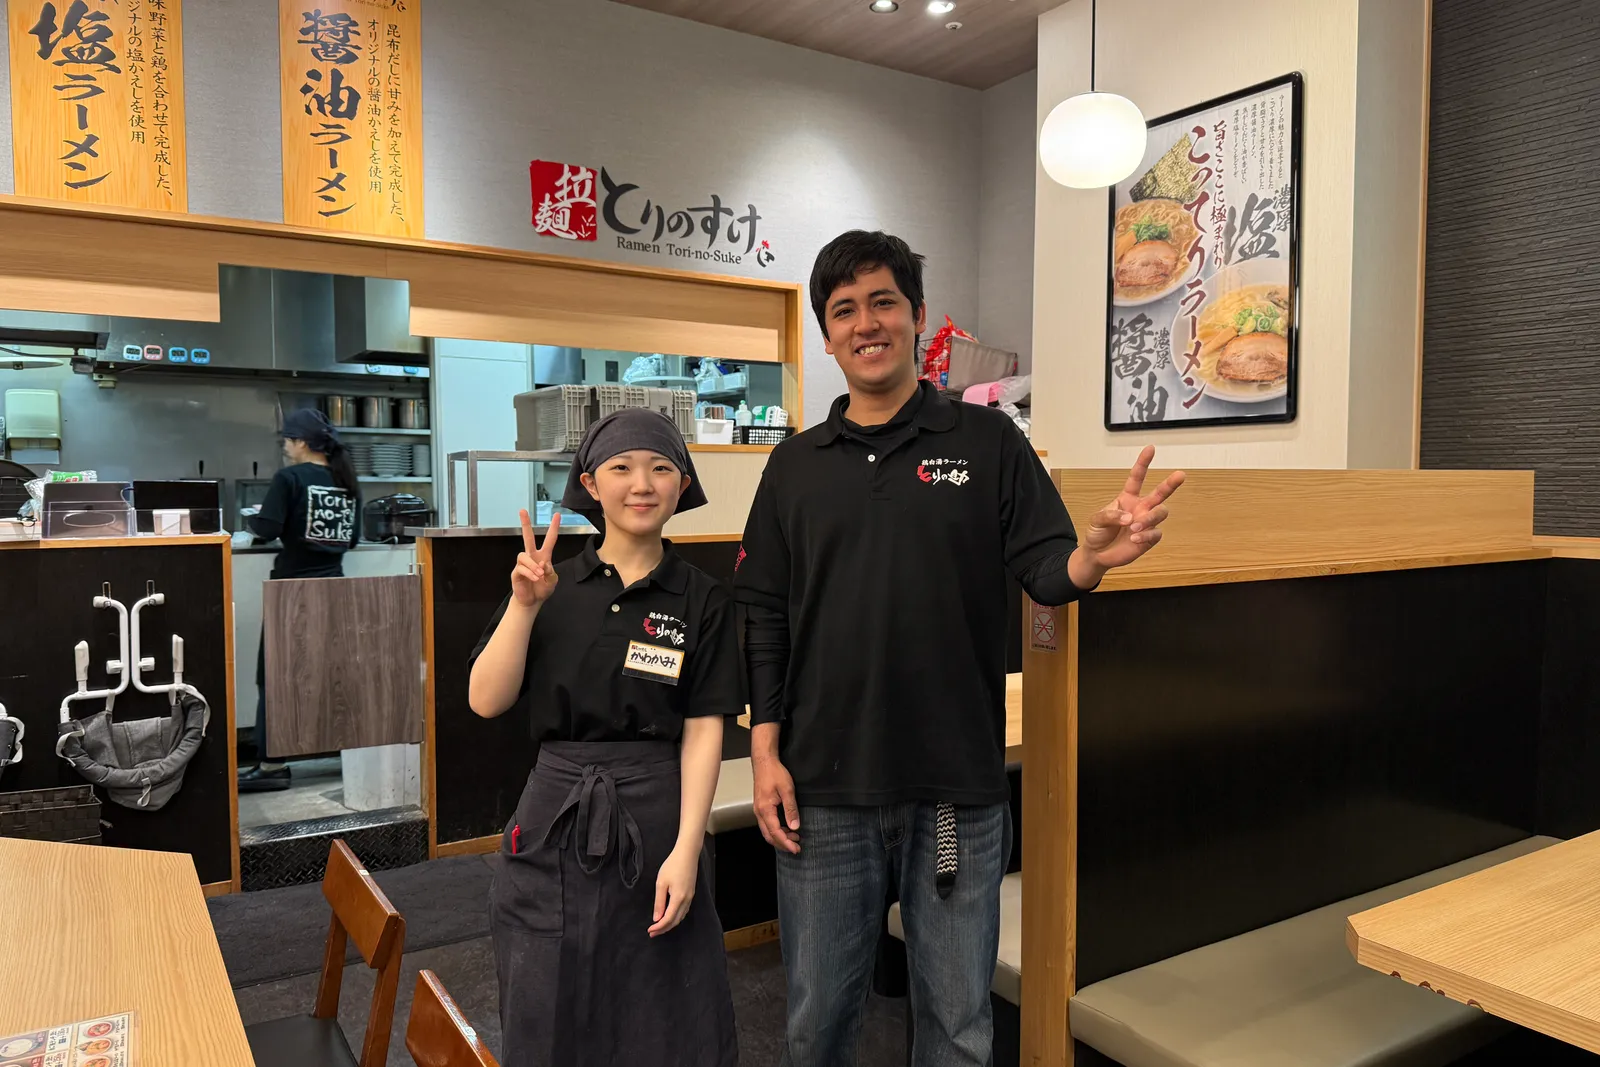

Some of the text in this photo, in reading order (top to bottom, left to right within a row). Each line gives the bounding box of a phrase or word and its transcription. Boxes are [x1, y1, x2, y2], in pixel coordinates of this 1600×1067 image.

[28, 0, 121, 190] 塩ラーメン
[126, 0, 147, 145] ジナルの塩かえしを使用
[297, 9, 363, 218] 醤油ラーメン
[367, 18, 384, 194] オリジナルの醤油かえしを使用
[385, 23, 404, 222] 昆布だしに甘みを加えて完成した、
[601, 166, 763, 256] とりのすけ
[616, 235, 742, 265] Ramen Tori-no-Suke
[1210, 119, 1227, 271] 旨さここに極まれり
[1222, 193, 1281, 266] 塩
[1181, 125, 1214, 410] こってりラーメン
[310, 520, 353, 540] Suke
[311, 489, 353, 509] Tori-
[314, 509, 343, 521] no-
[631, 652, 676, 668] かわかみ
